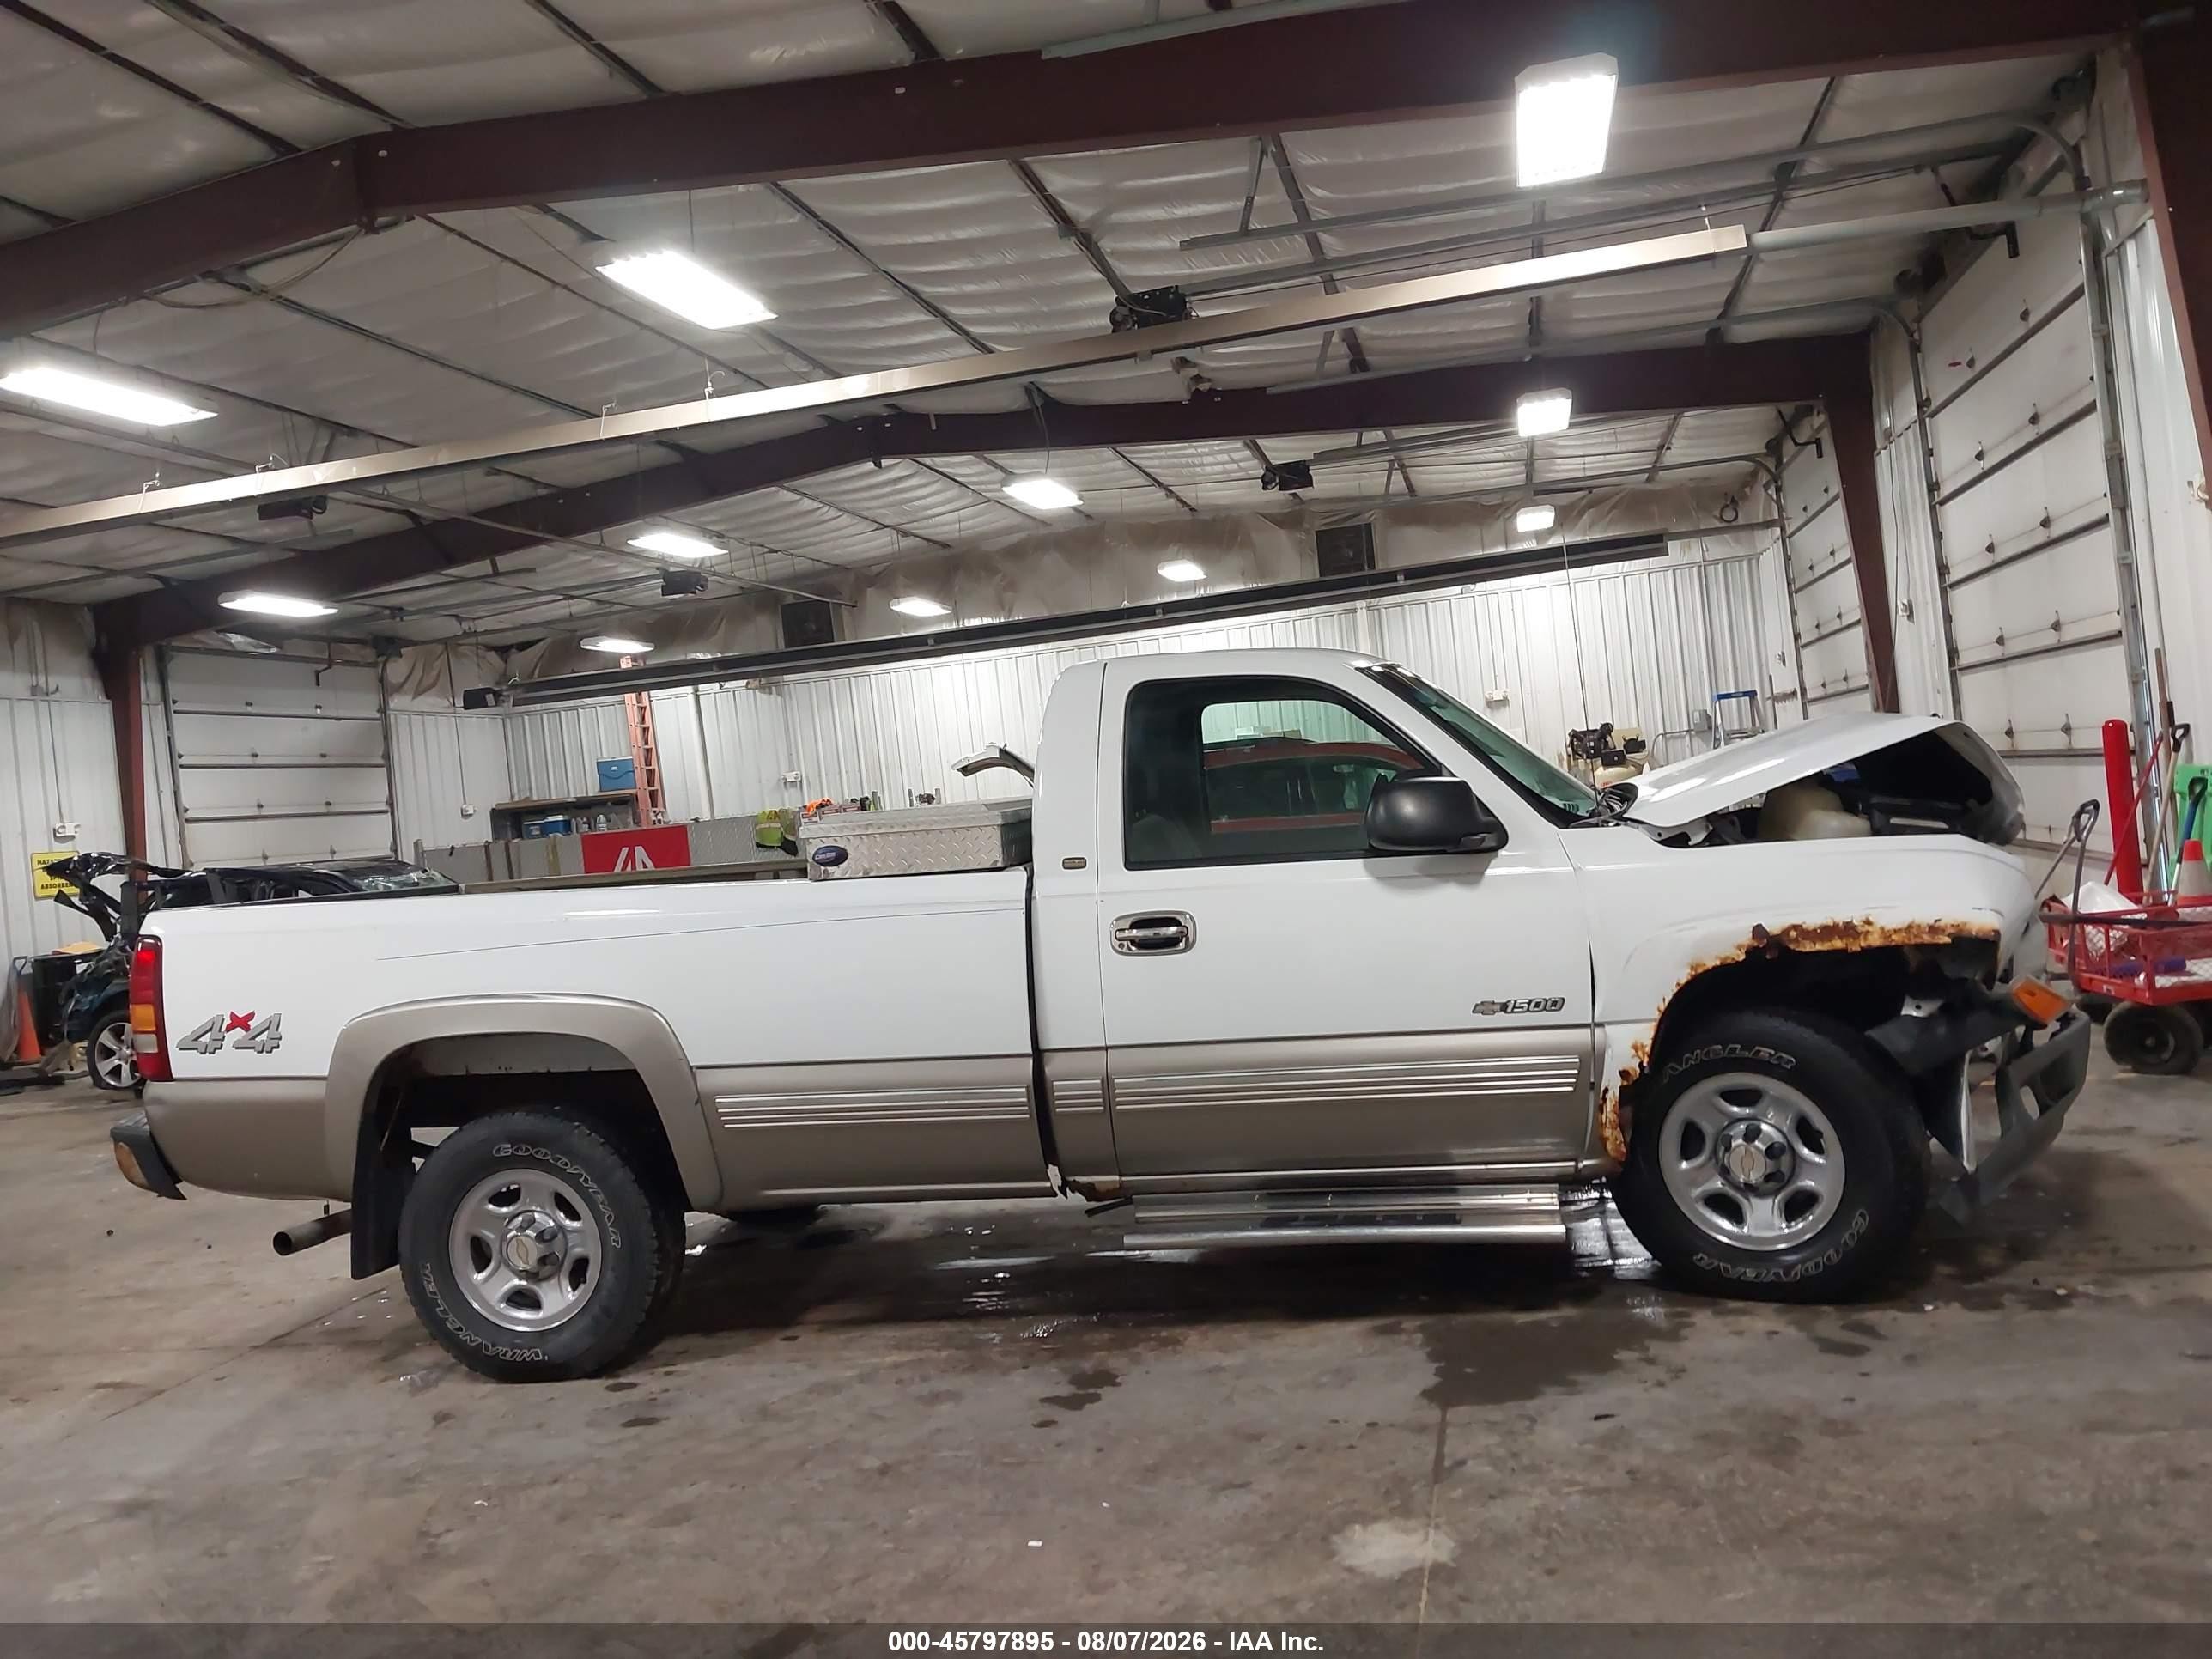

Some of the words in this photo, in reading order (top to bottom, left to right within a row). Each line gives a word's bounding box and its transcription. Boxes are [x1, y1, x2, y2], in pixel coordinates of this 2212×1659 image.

[1504, 996, 1565, 1014] 1500
[492, 1143, 623, 1249] GOODYEAR
[1692, 1208, 1869, 1283] GOODYEAR
[420, 1259, 543, 1362] WRANGLER
